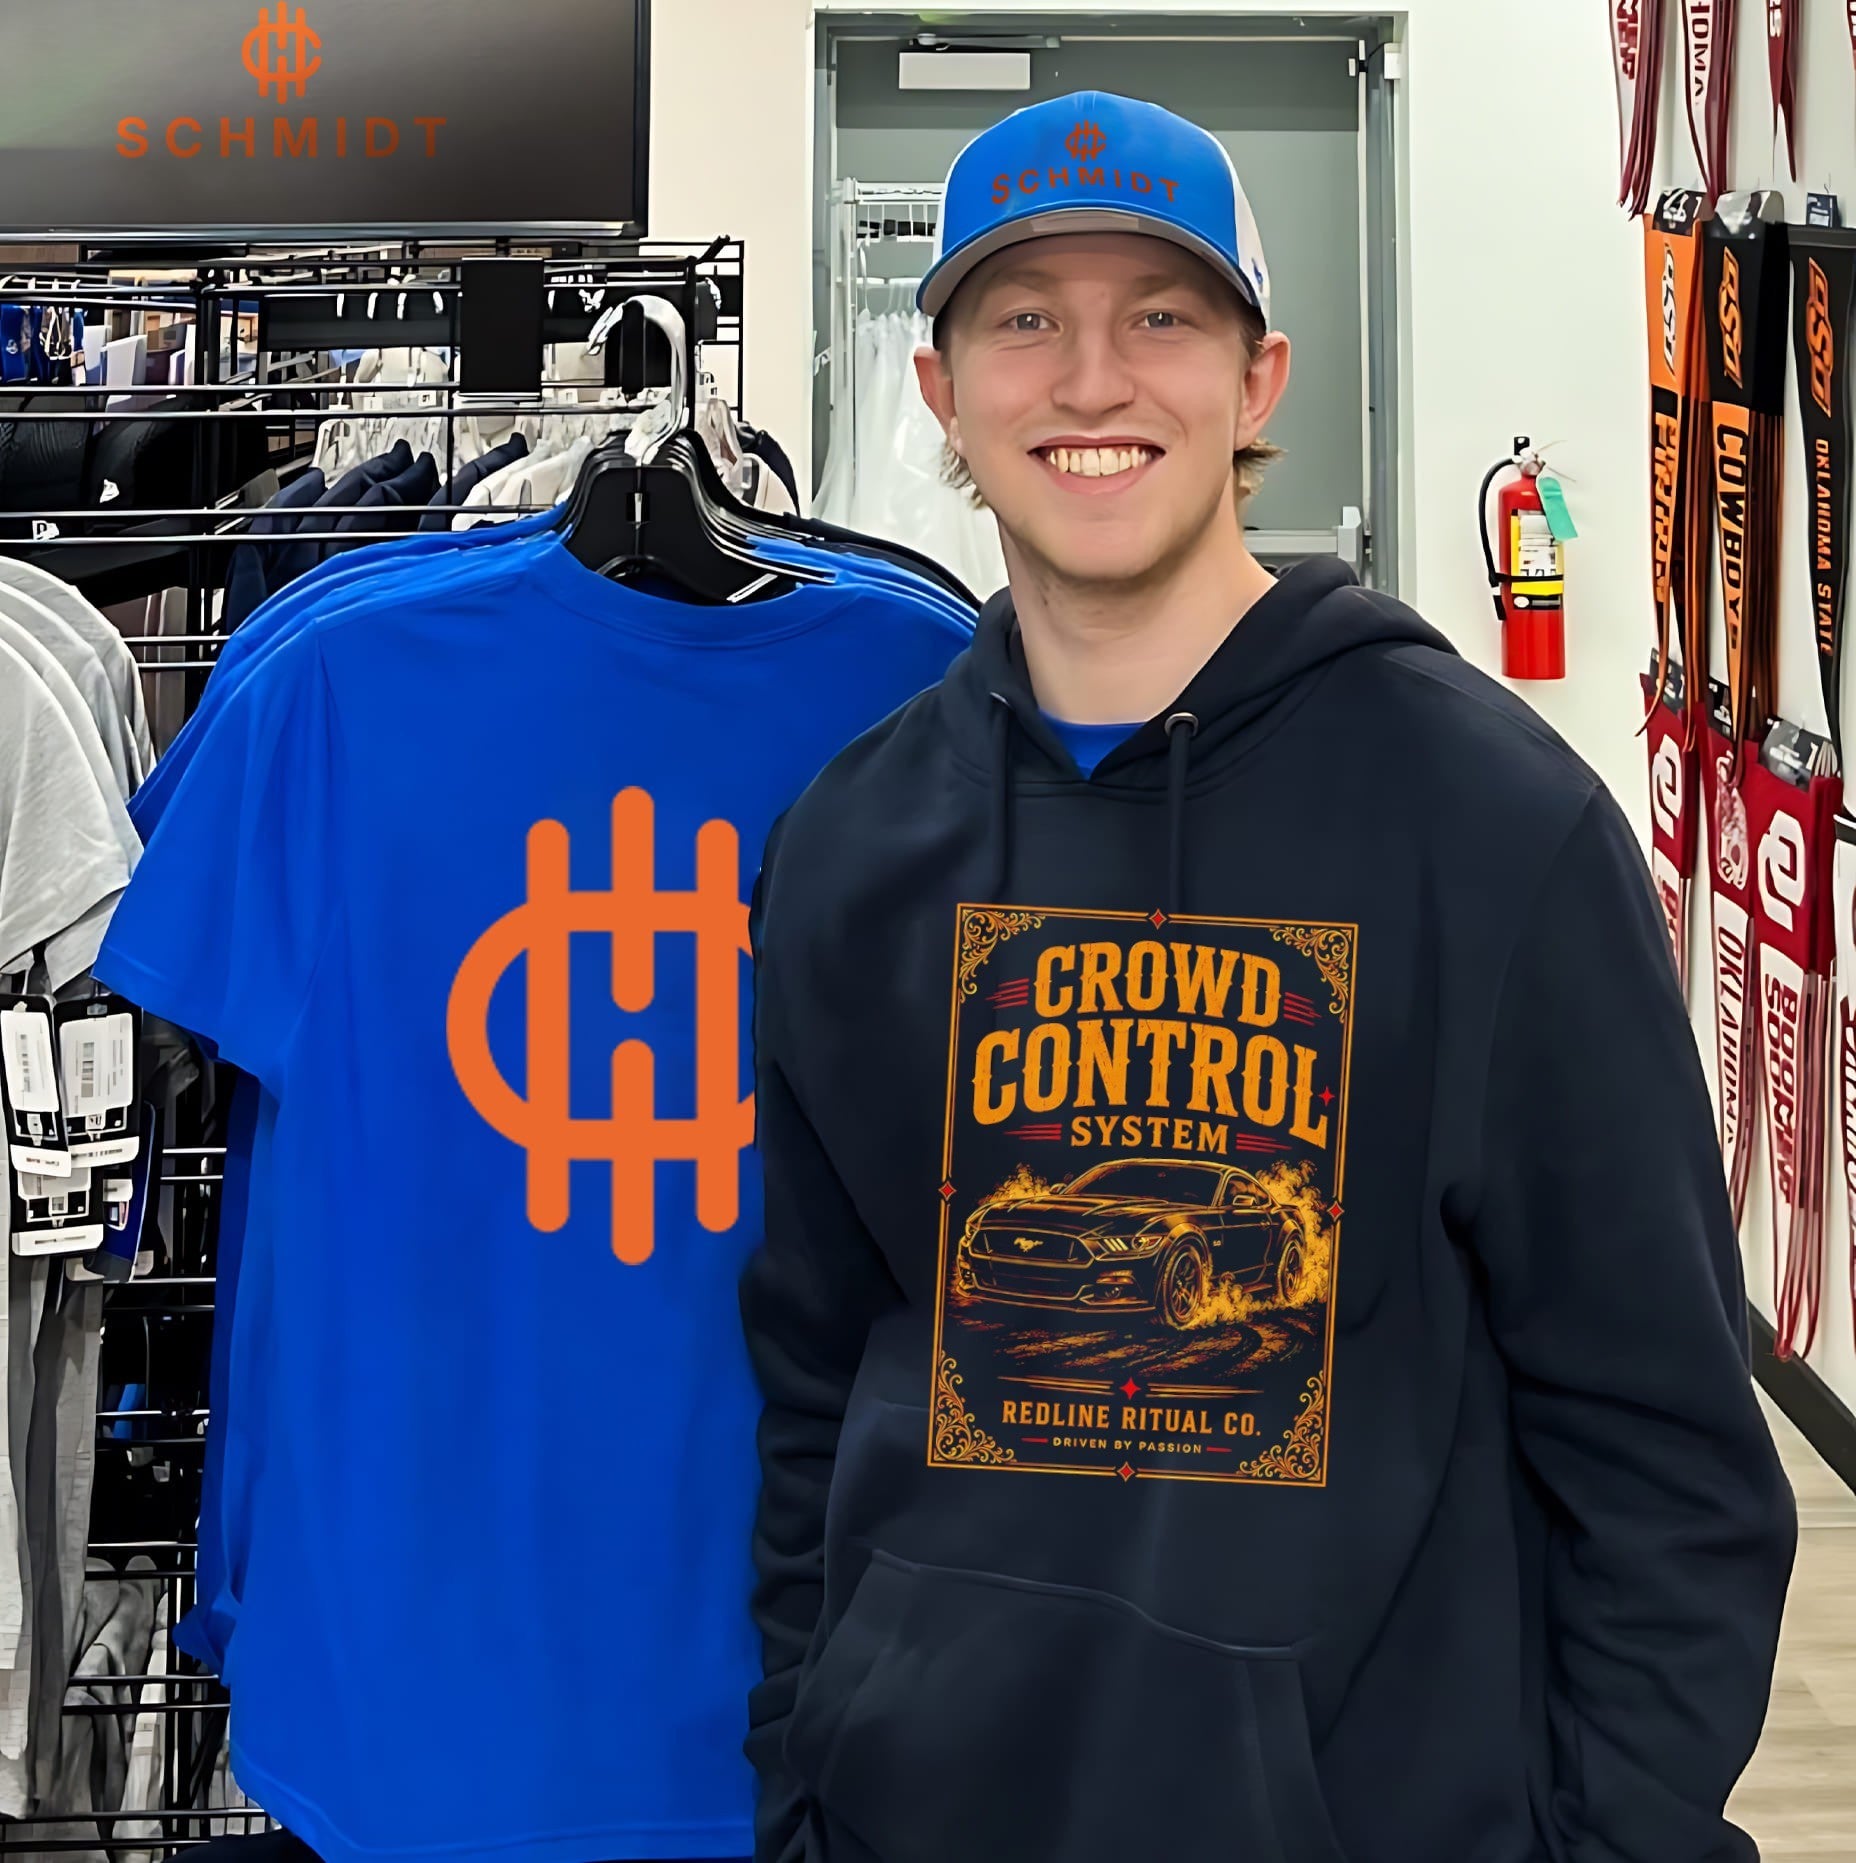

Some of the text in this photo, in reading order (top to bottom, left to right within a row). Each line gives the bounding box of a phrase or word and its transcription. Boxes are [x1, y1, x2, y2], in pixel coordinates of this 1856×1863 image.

[115, 116, 448, 159] SCHMIDT
[991, 166, 1179, 204] SCHMIDT
[1815, 438, 1832, 569] OKLAHOMA
[1033, 940, 1282, 1028] CROWD
[971, 1018, 1329, 1150] CONTROL
[1070, 1115, 1229, 1155] SYSTEM
[1001, 1400, 1262, 1437] REDLINE RITUAL CO.
[1052, 1436, 1202, 1454] DRIVEN BY PASSION
